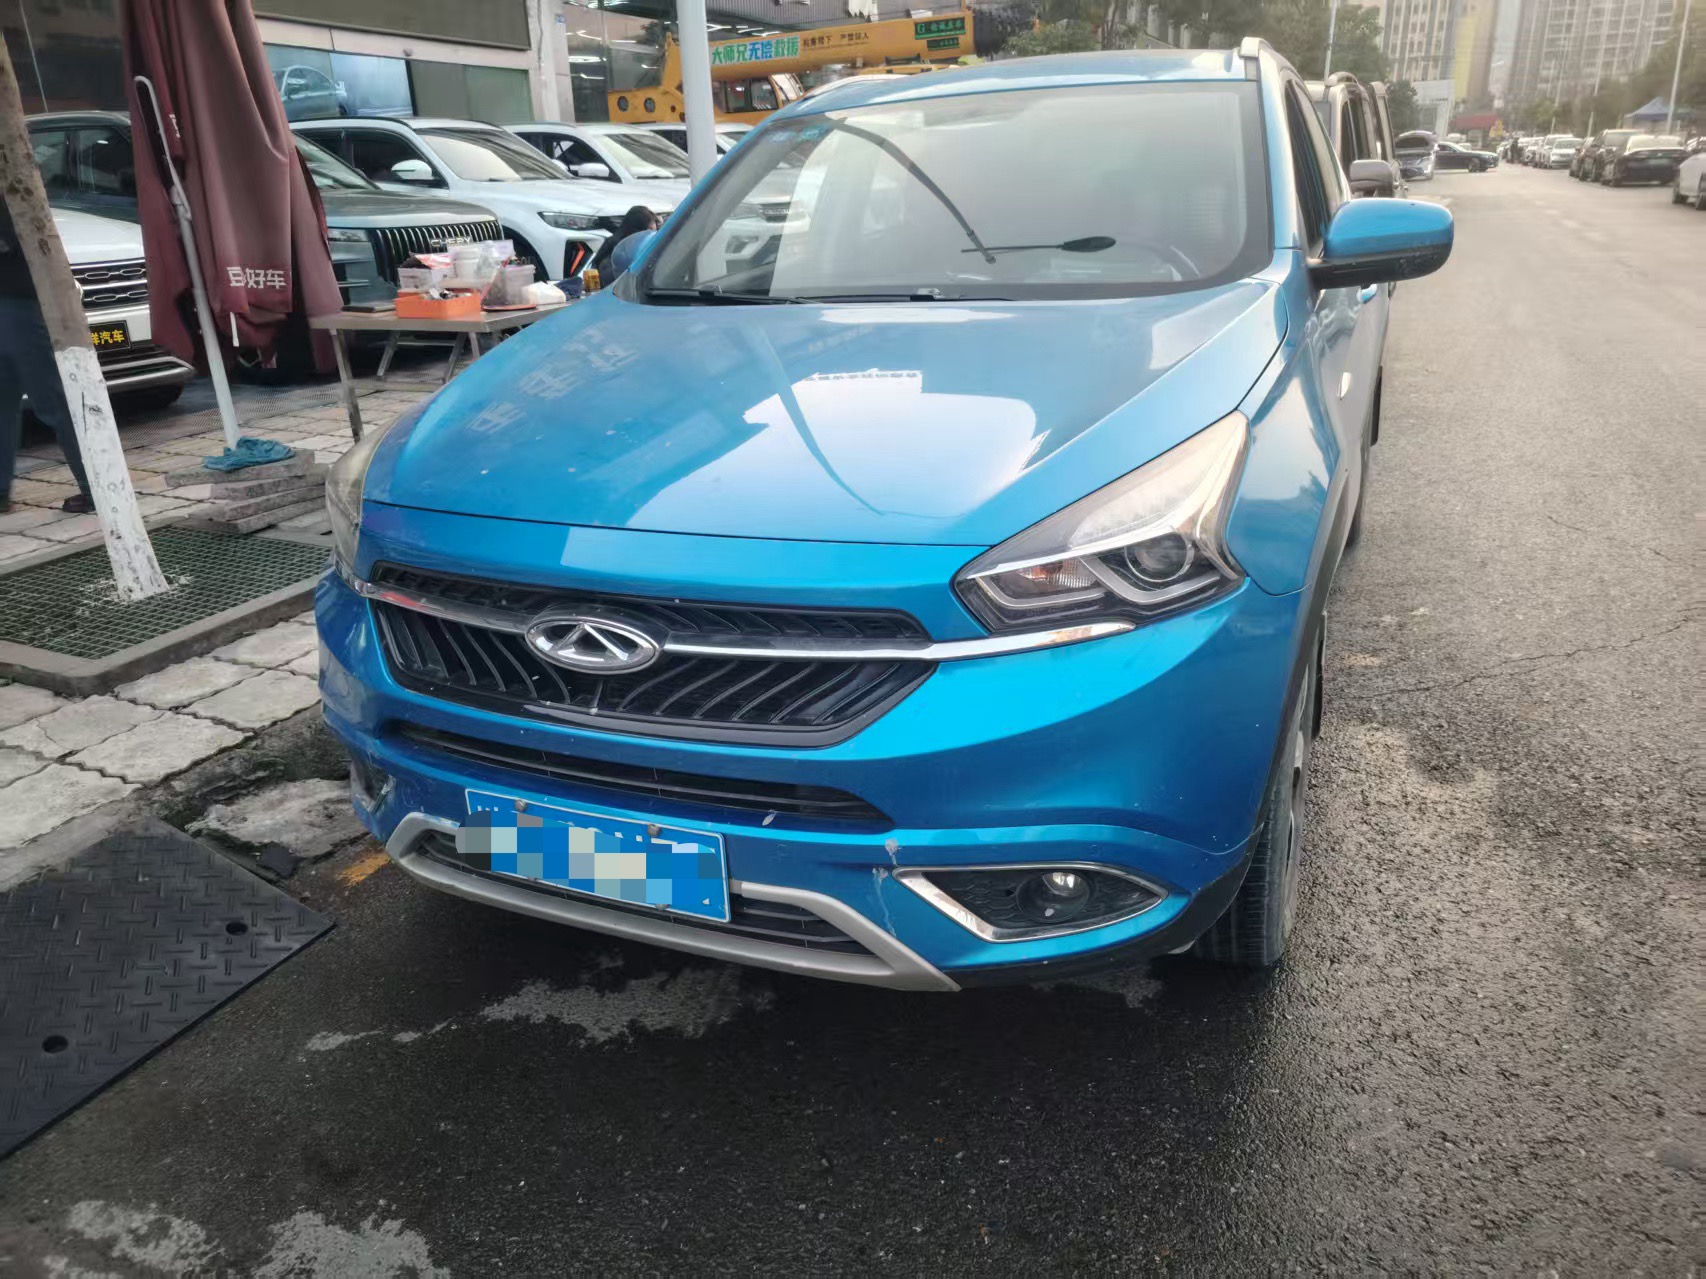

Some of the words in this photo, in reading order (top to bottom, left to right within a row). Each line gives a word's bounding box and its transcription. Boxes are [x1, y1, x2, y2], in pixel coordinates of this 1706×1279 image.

[711, 36, 800, 64] 大师兄无偿救援
[430, 236, 471, 248] CHERY
